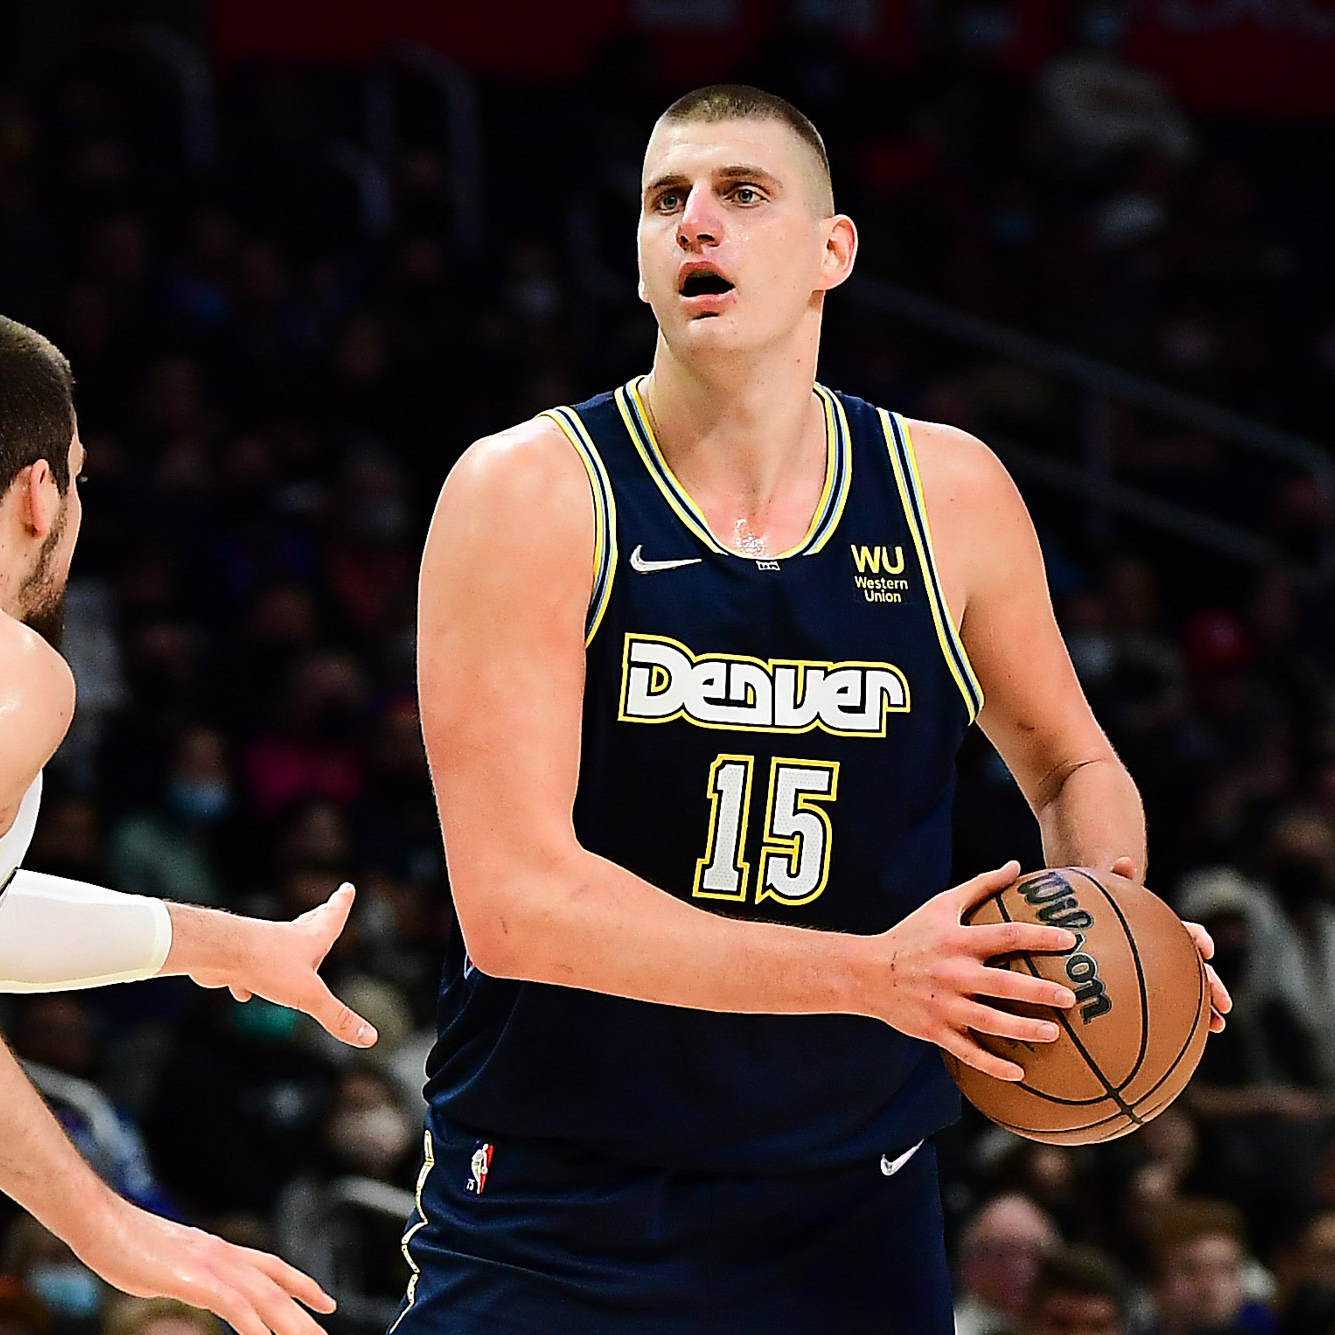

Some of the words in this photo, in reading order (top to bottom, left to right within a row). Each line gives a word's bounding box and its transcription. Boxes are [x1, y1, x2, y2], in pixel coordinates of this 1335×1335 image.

[850, 544, 905, 575] WU
[854, 575, 909, 590] Western
[864, 588, 902, 603] Union
[618, 632, 911, 738] Denver
[692, 753, 840, 906] 15
[1017, 870, 1112, 1025] Wilon
